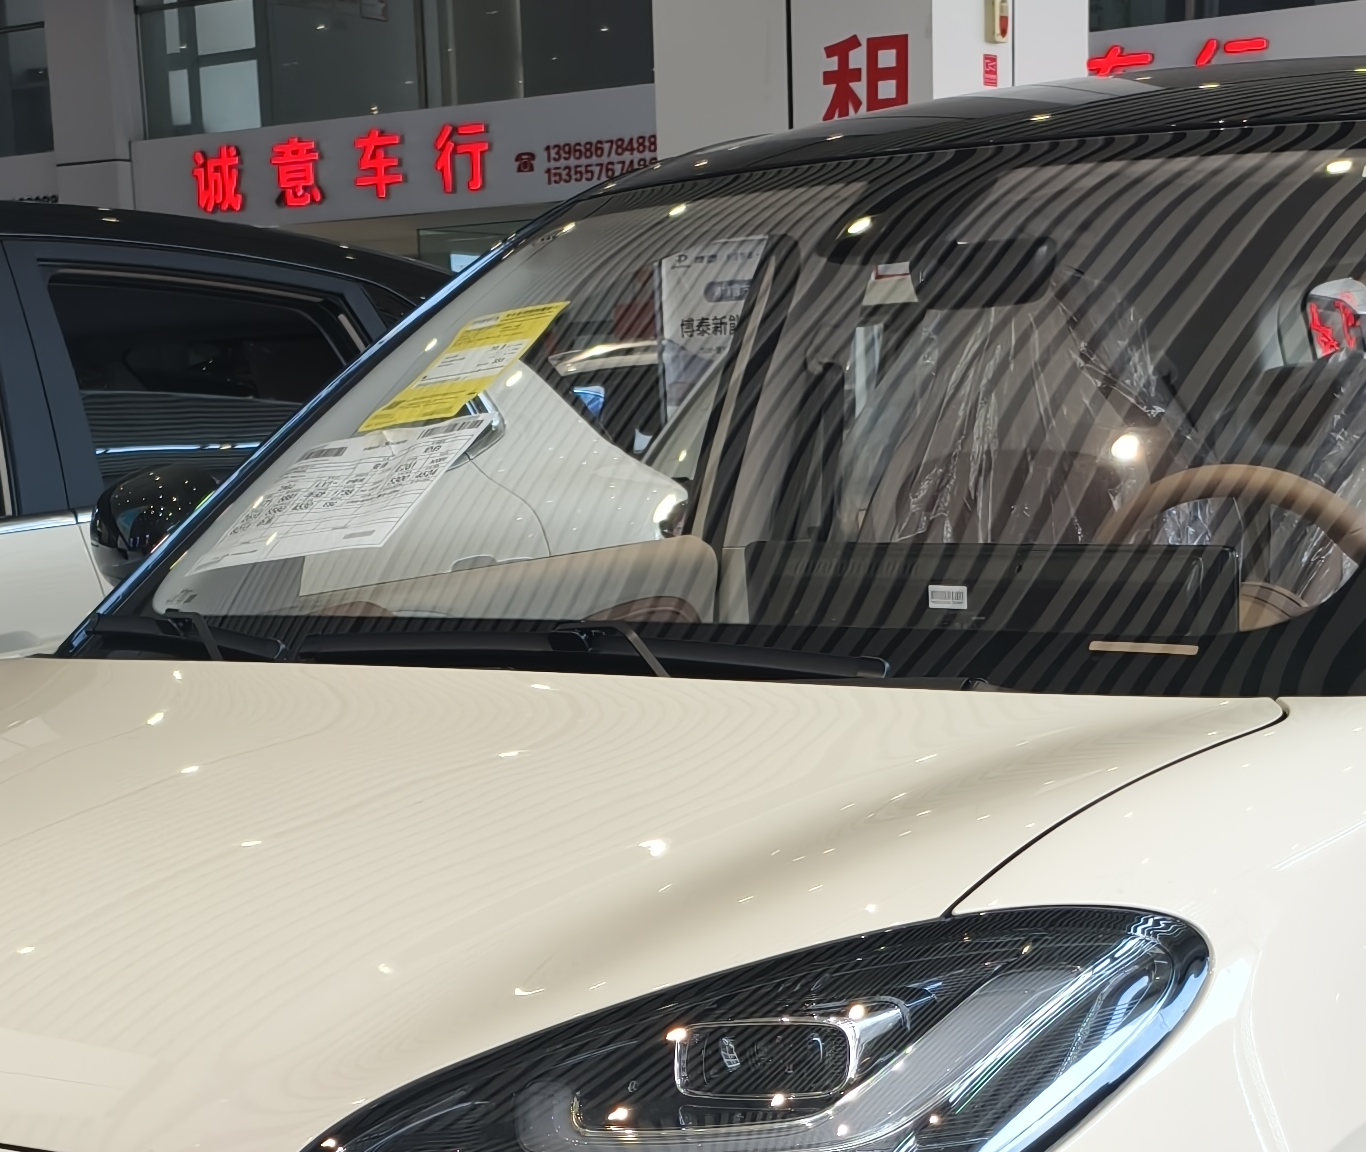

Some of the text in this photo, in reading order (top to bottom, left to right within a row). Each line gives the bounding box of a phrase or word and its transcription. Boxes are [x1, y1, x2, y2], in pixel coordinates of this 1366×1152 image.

[822, 34, 909, 121] 租
[192, 123, 490, 213] 诚意车行
[544, 134, 658, 163] 13968678488
